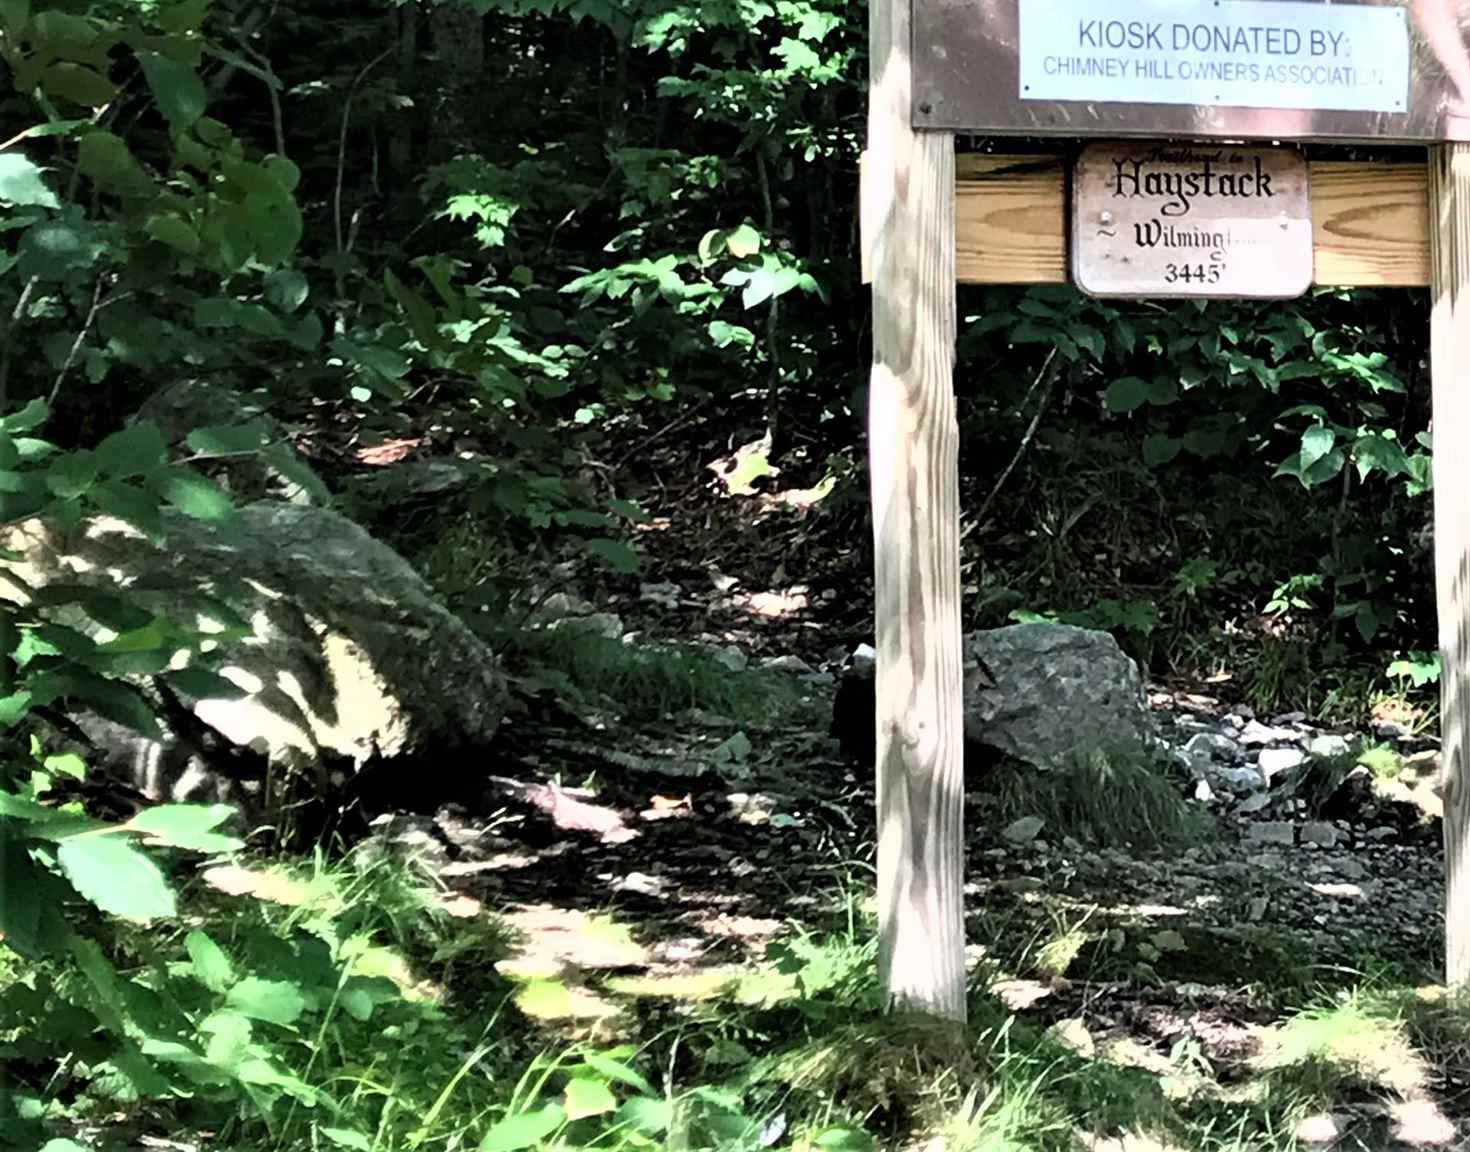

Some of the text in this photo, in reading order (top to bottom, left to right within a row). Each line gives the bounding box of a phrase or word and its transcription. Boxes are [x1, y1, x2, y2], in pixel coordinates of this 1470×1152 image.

[1079, 19, 1350, 59] KIOSK DONATED BY:
[1043, 56, 1384, 87] CHIMNEY HILL OWNERS ASSOCIATI
[1111, 156, 1275, 216] Haystack
[1165, 263, 1227, 284] 3445'
